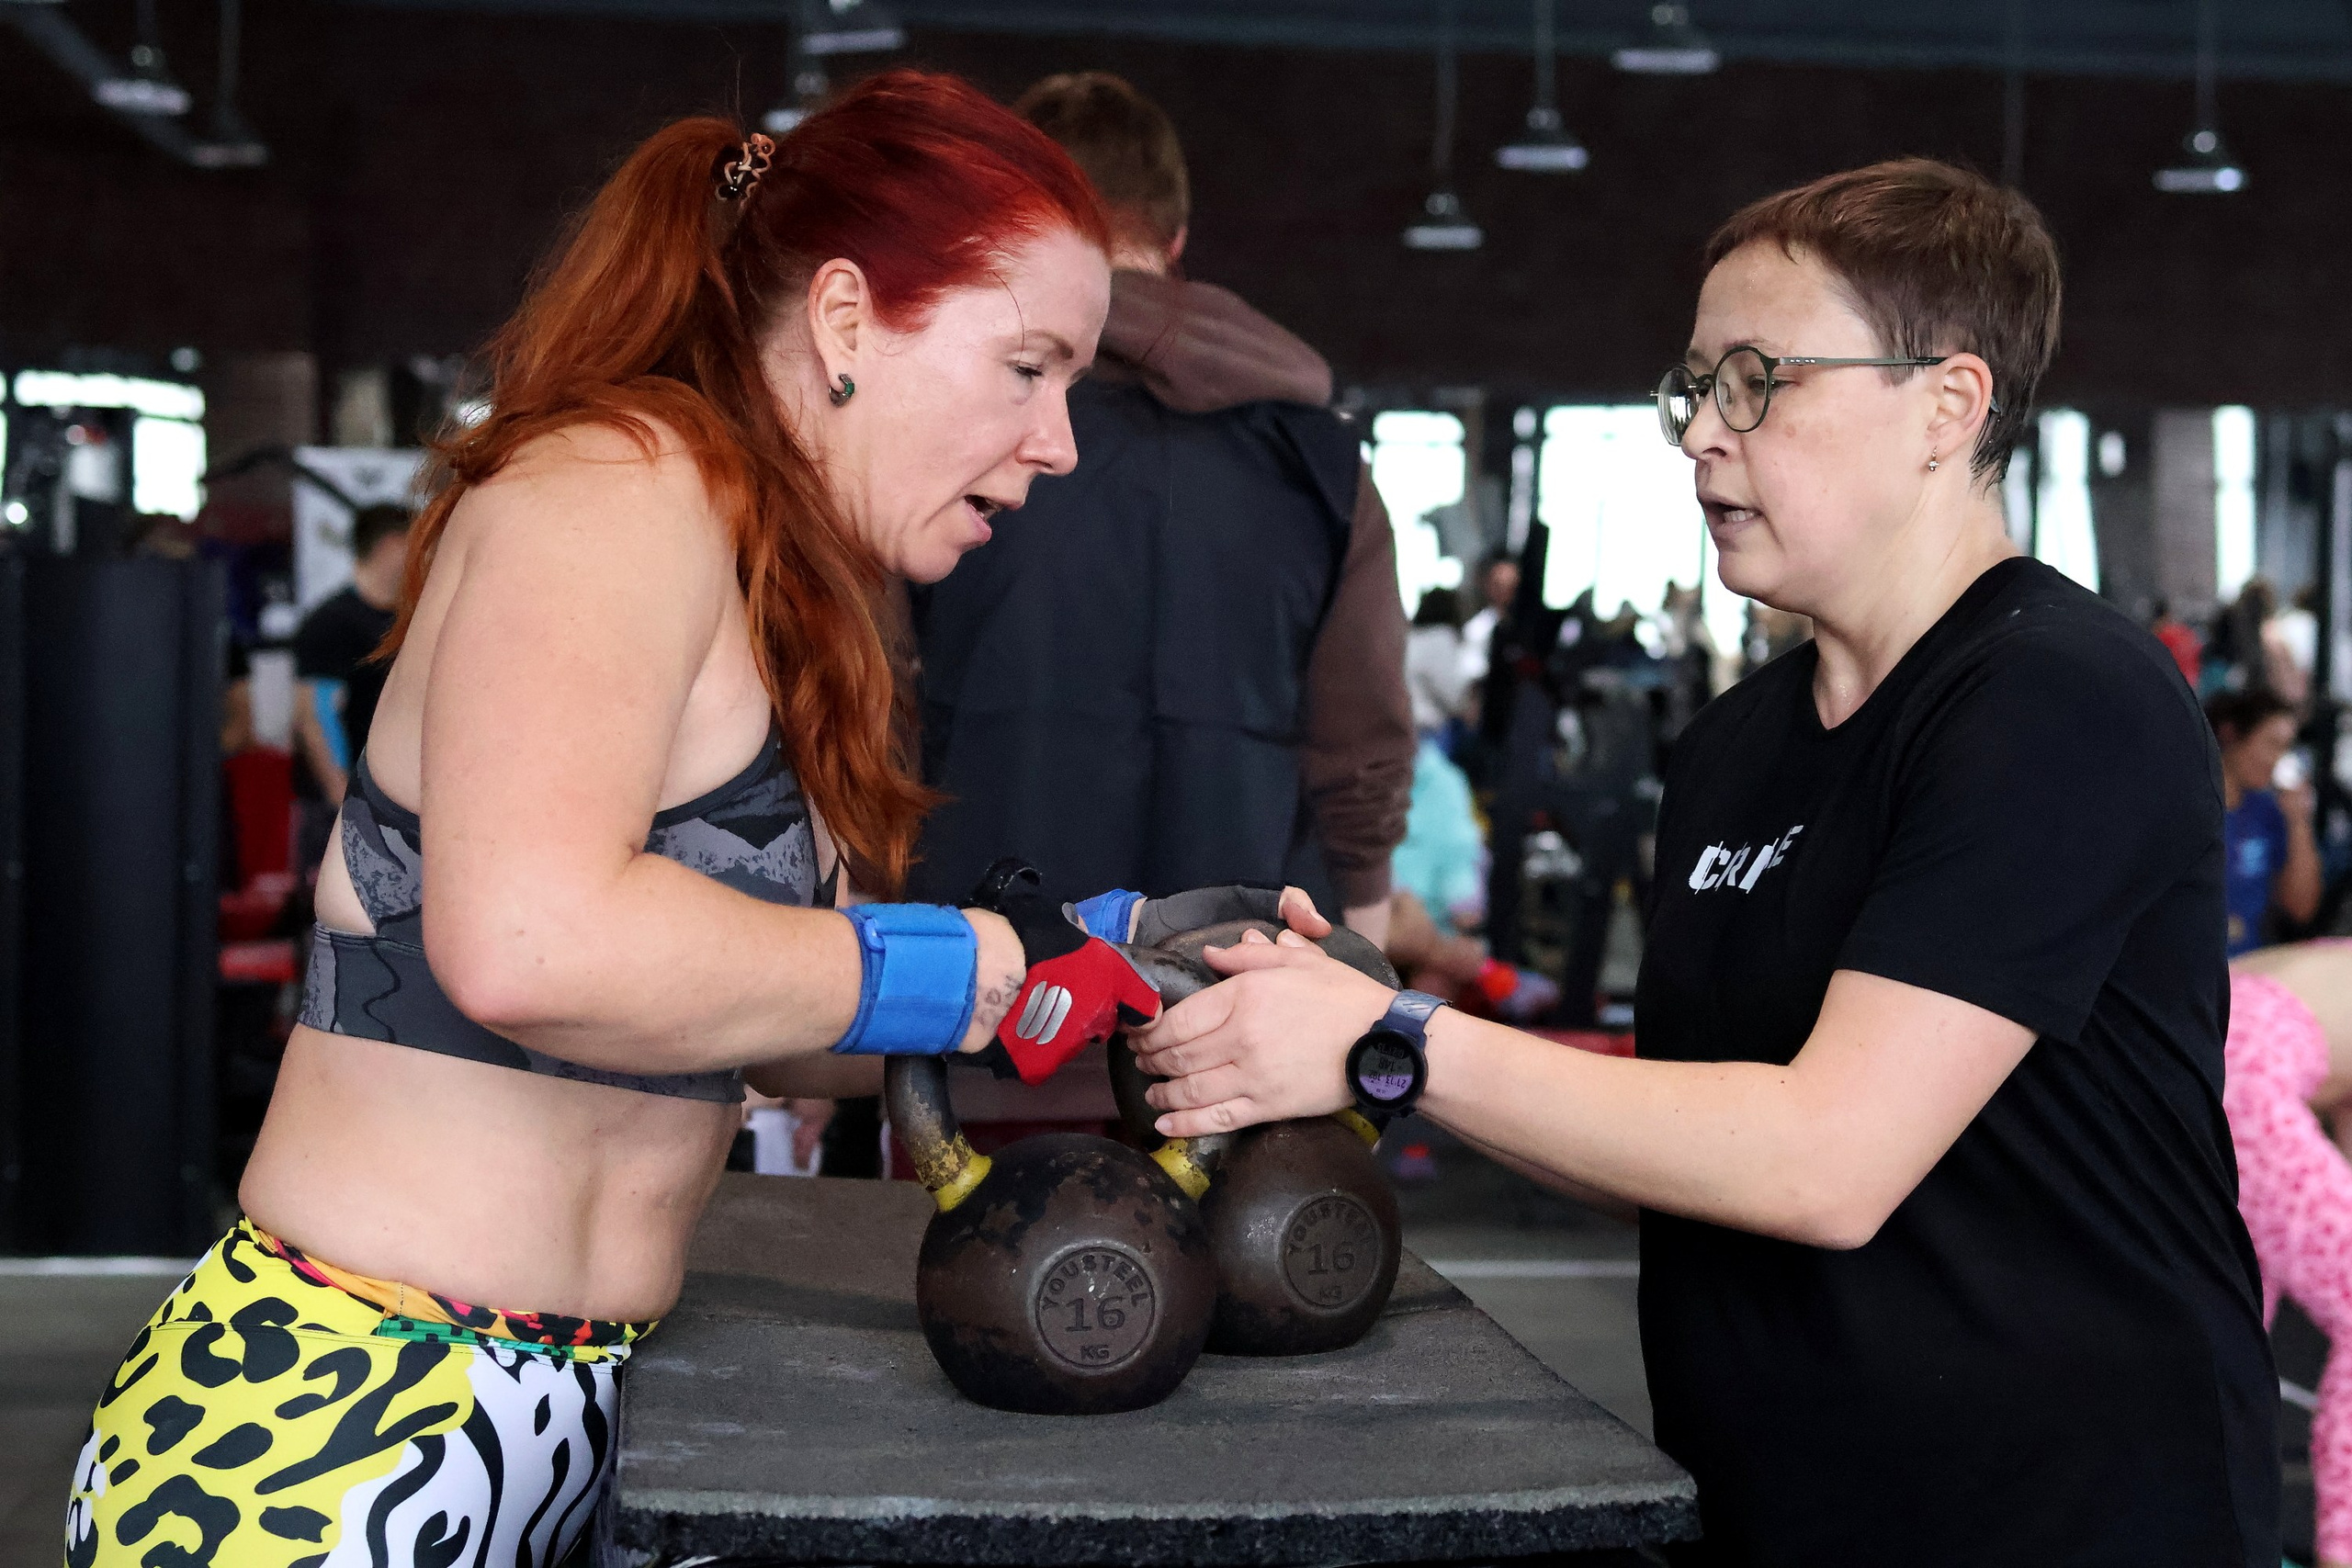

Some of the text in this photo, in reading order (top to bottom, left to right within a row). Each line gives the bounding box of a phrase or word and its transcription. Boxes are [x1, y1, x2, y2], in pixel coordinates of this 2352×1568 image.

[1288, 1201, 1372, 1256] YOUSTEEL
[1308, 1242, 1354, 1275] 16
[1042, 1254, 1148, 1312] YOUSTEEL
[1065, 1295, 1125, 1332] 16
[1080, 1344, 1110, 1359] KG
